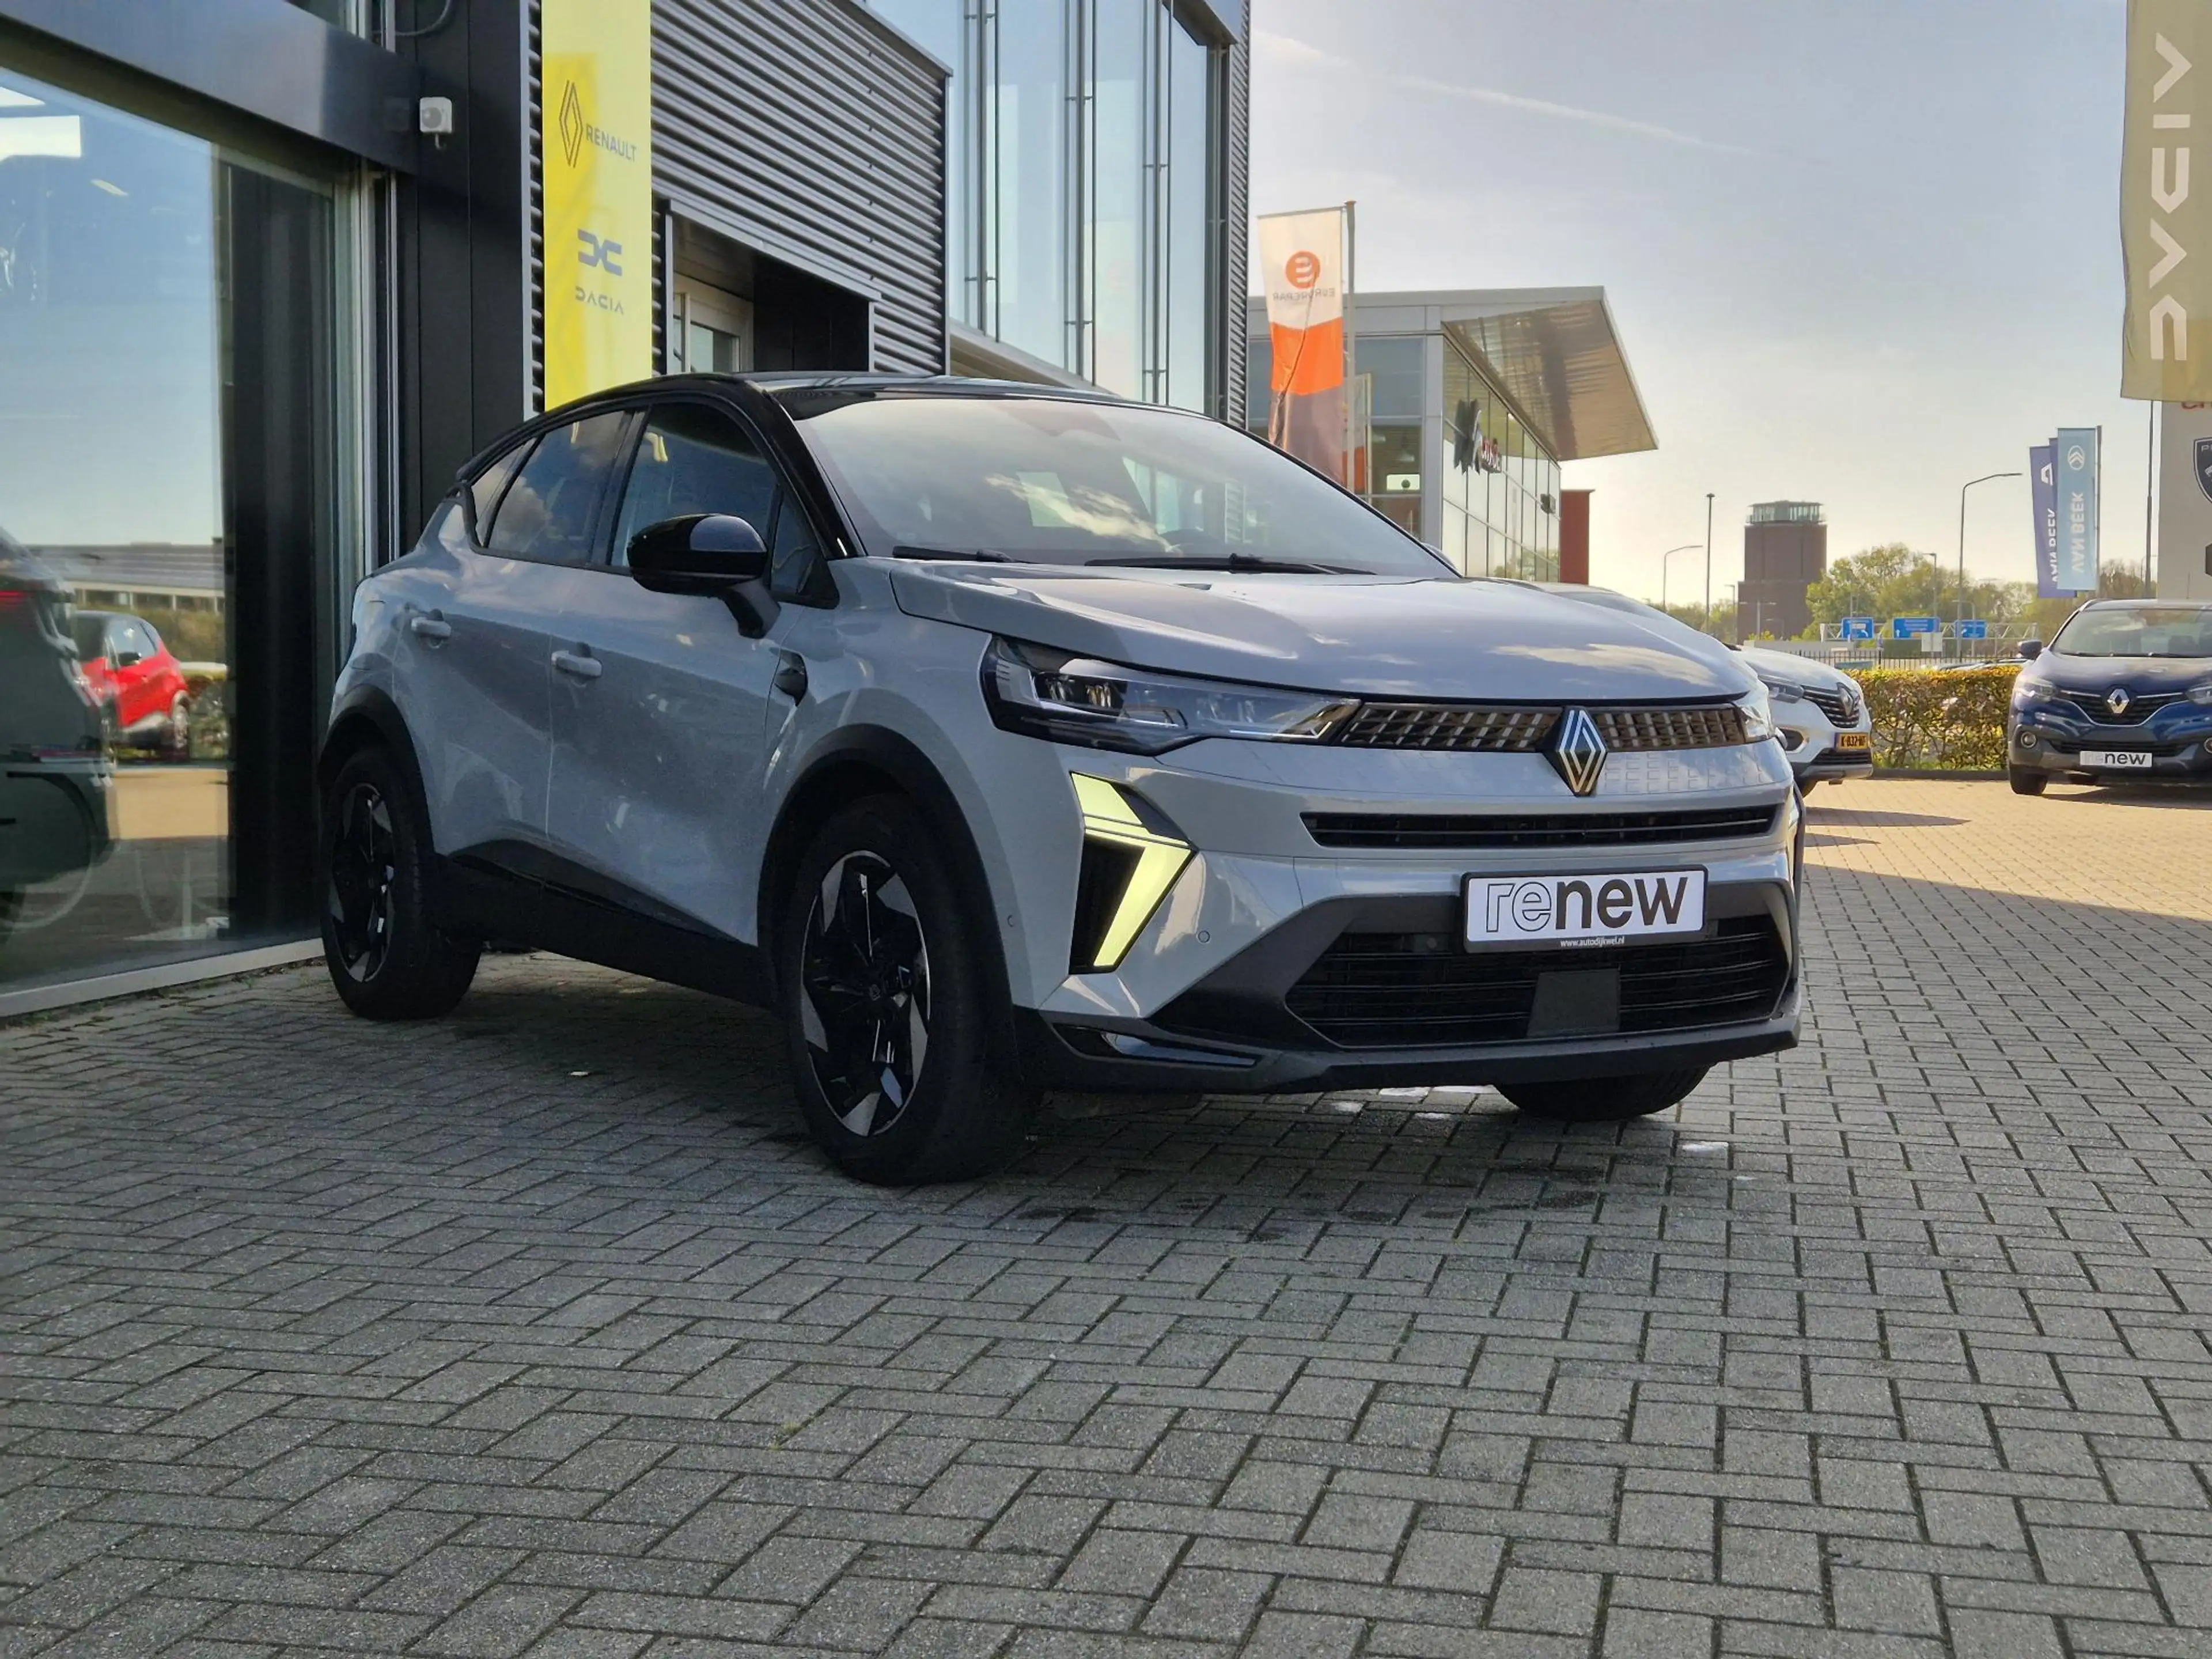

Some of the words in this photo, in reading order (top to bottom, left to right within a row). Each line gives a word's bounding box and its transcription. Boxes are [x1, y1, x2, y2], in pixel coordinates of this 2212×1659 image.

[585, 123, 637, 162] RENAULT
[575, 286, 624, 315] DACIA
[1486, 876, 1688, 933] renew
